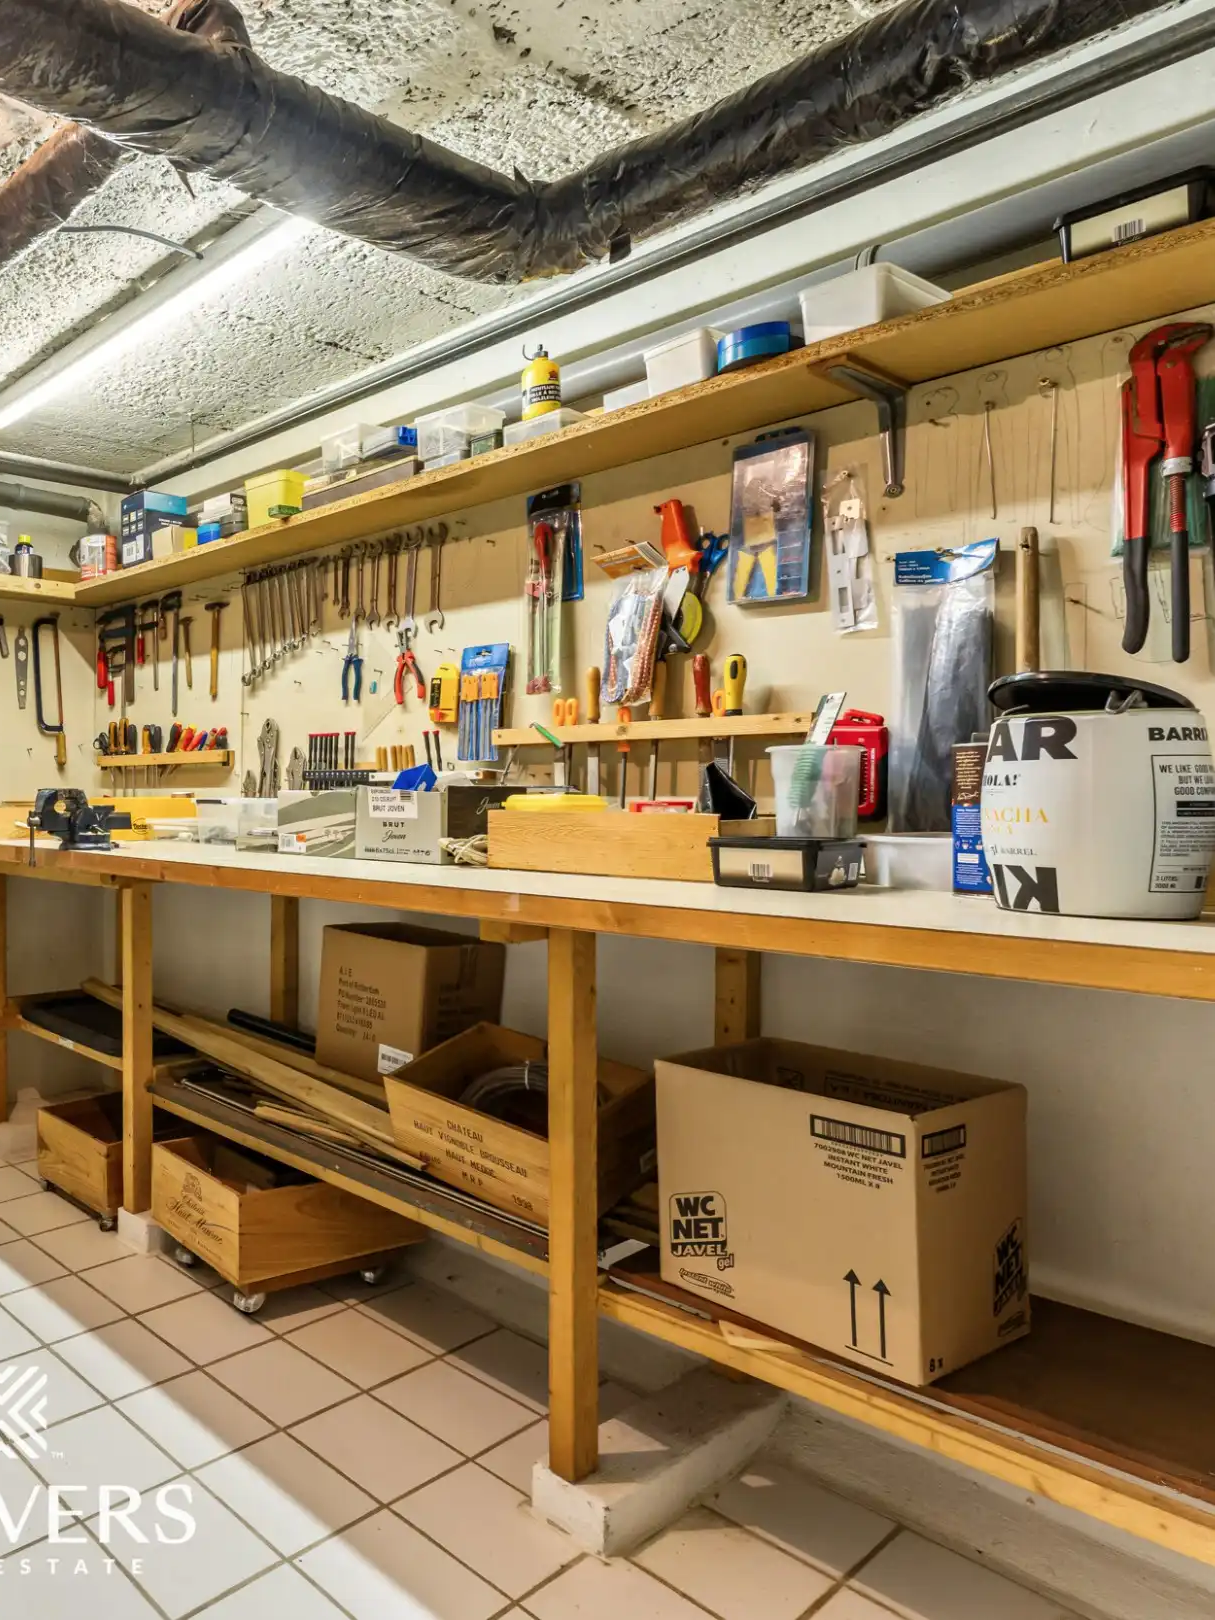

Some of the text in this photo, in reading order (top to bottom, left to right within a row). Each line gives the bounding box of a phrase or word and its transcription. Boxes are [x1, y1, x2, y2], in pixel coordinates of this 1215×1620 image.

[1159, 764, 1173, 774] WE
[1175, 764, 1191, 774] LIKE
[1174, 786, 1195, 796] GOOD
[446, 1119, 484, 1143] CHATEAU
[846, 1150, 860, 1160] WC
[878, 1157, 903, 1170] JAVEL
[862, 1163, 889, 1175] WHITE
[823, 1160, 894, 1185] MOUNTAIN FRESH
[675, 1195, 716, 1218] WC
[673, 1217, 724, 1240] NET
[672, 1244, 728, 1257] JAVEL
[717, 1253, 735, 1272] gel
